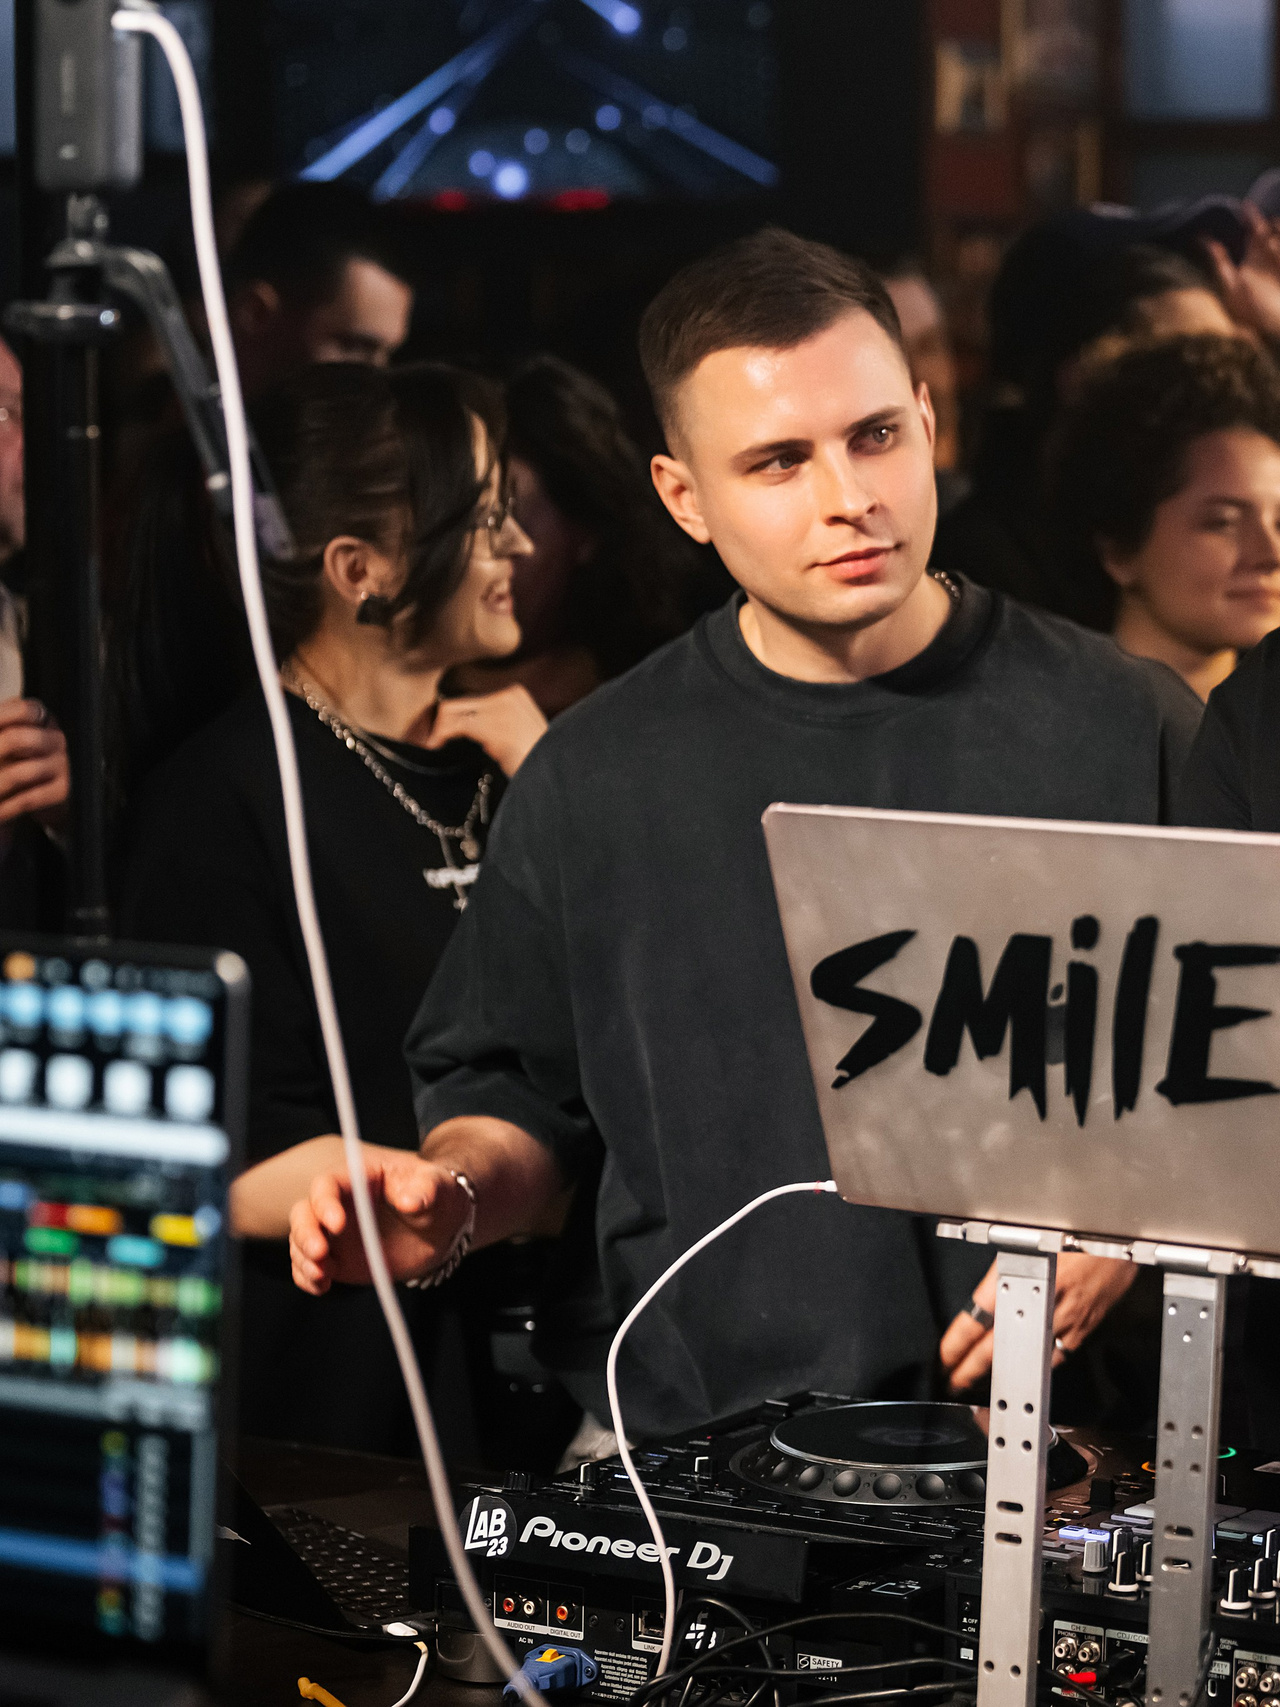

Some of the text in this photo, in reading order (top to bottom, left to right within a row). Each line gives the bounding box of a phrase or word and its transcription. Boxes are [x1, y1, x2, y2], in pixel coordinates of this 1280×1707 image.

[464, 1496, 508, 1551] LAB
[486, 1536, 508, 1557] 23
[507, 1622, 535, 1632] AUDIO OUT
[550, 1628, 569, 1637] DIGITAL
[812, 1657, 839, 1668] SAFETY
